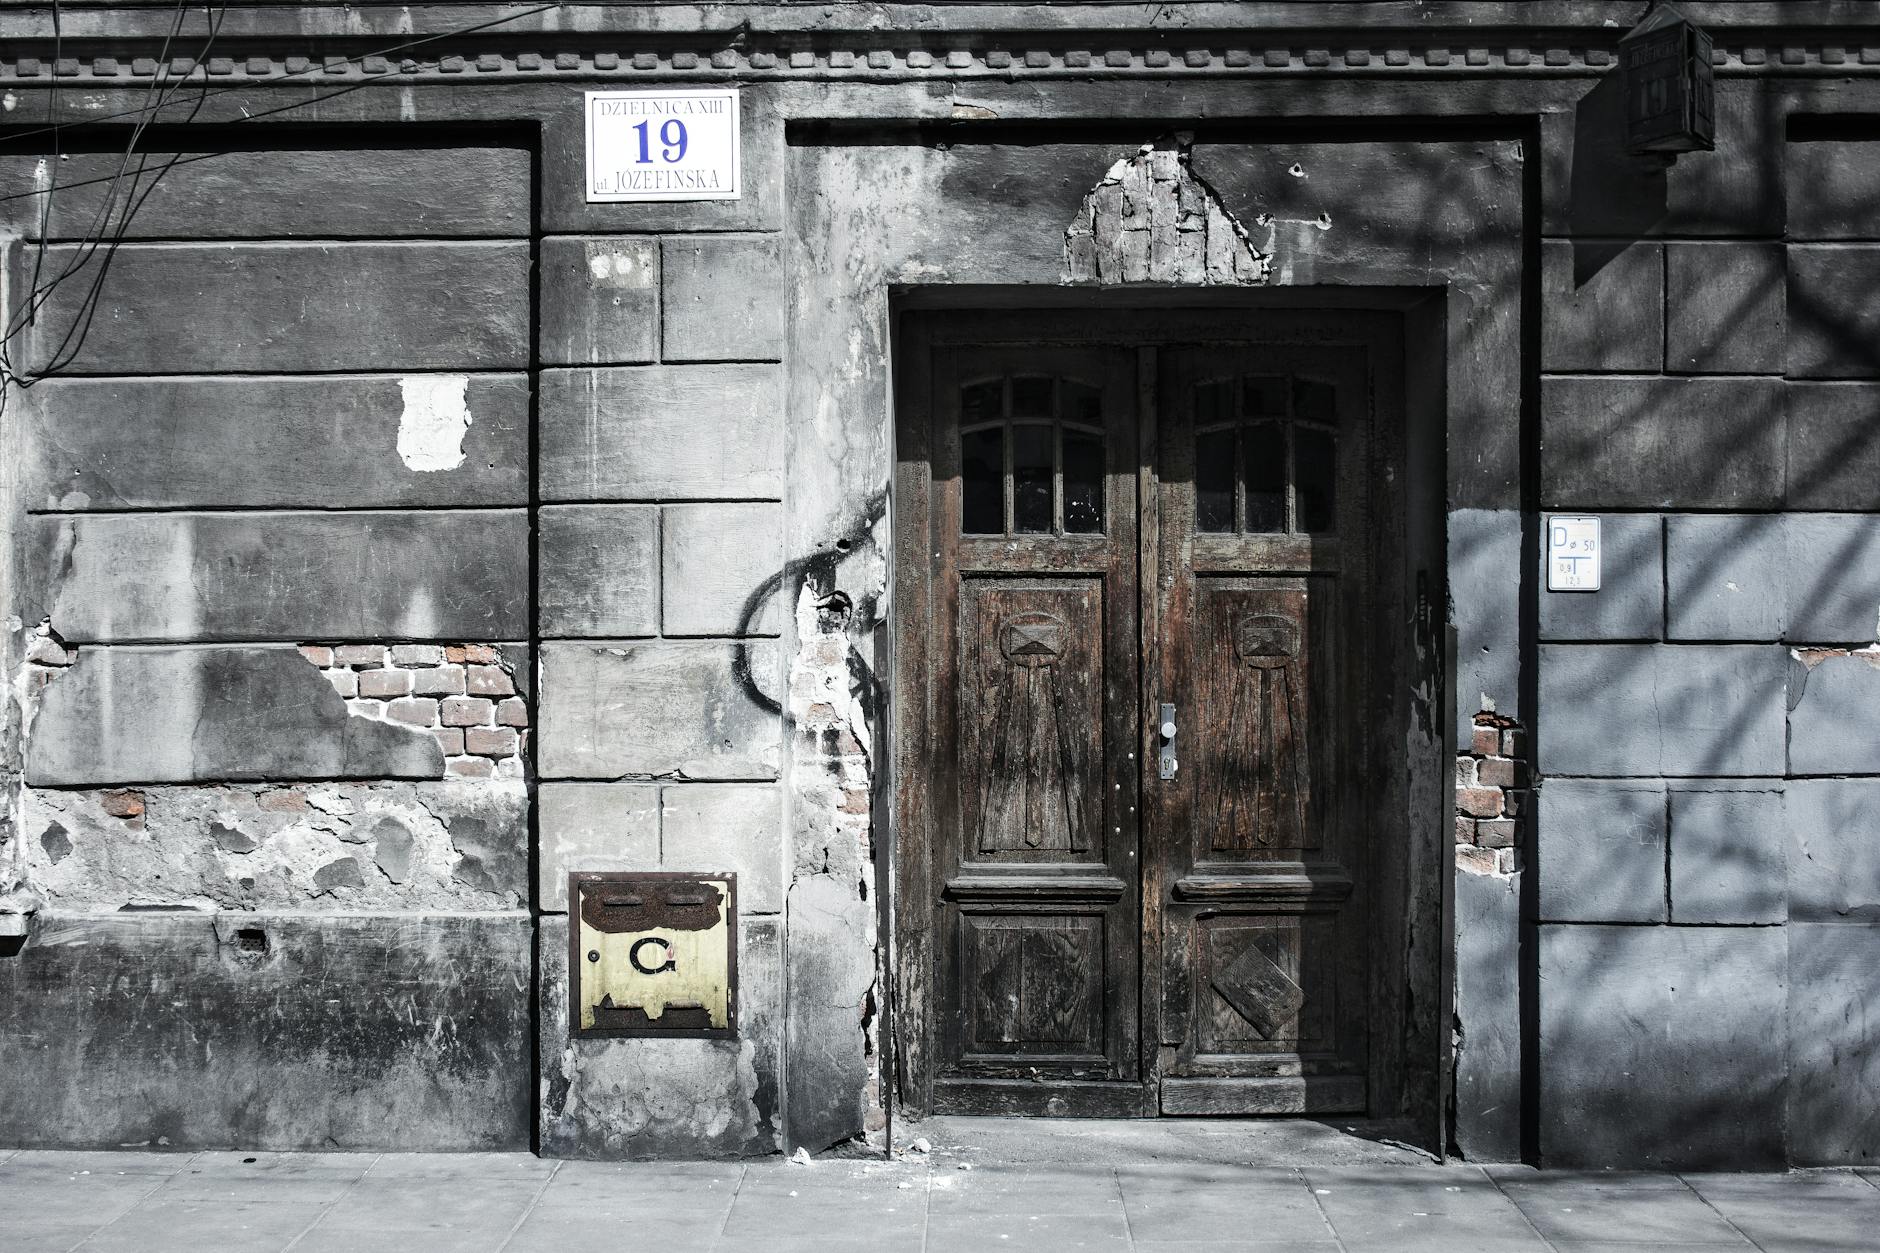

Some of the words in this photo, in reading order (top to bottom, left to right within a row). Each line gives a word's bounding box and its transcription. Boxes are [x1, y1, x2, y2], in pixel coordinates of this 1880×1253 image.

[601, 100, 694, 116] DZIELNICA
[698, 100, 723, 114] XIII
[632, 118, 688, 164] 19
[1553, 526, 1567, 547] D
[1584, 540, 1595, 552] 50
